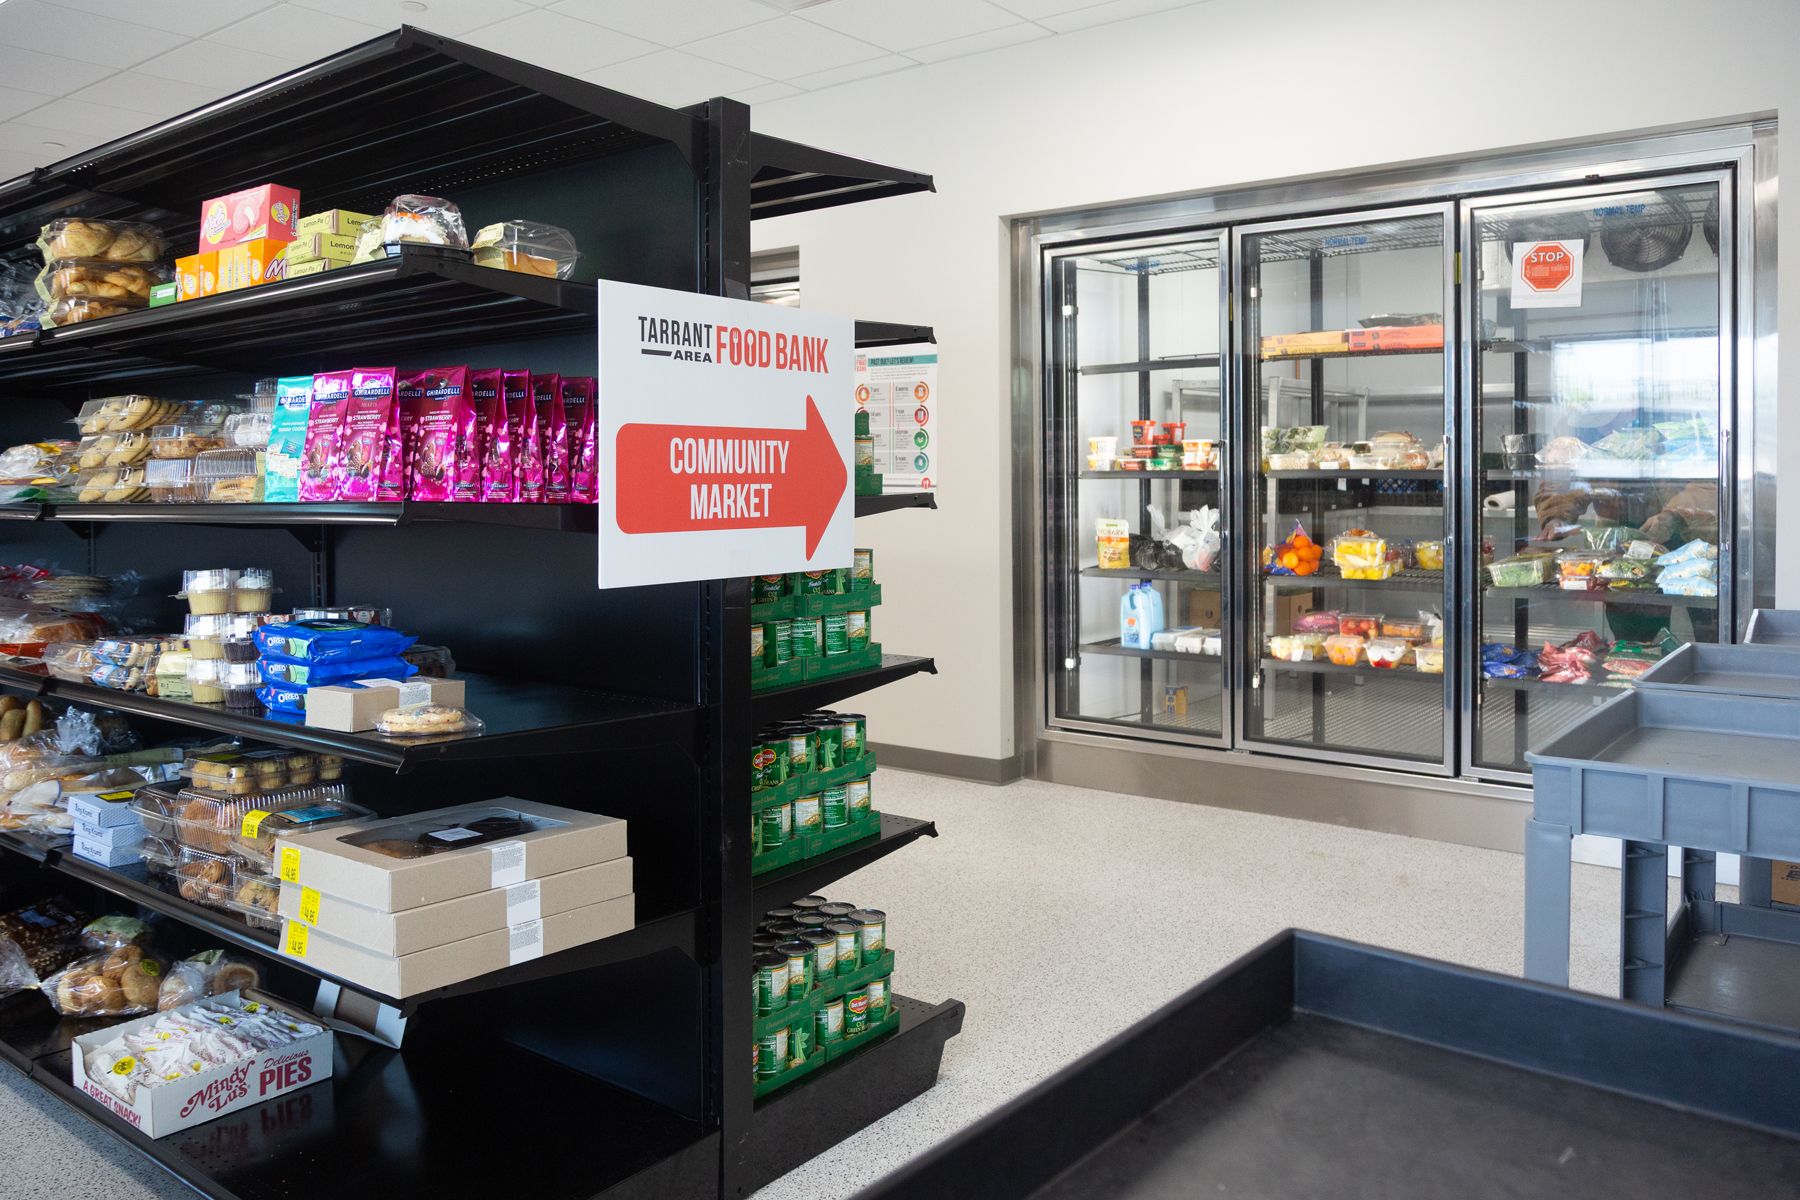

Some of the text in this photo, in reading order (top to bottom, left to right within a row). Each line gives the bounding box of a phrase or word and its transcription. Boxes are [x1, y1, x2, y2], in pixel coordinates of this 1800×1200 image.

[1593, 203, 1646, 217] NORMAL TEMP
[330, 240, 355, 250] Lemon
[1530, 251, 1565, 264] STOP
[638, 315, 713, 348] TARRANT
[673, 349, 713, 363] AREA
[716, 325, 829, 374] FOOD BANK
[427, 387, 460, 396] GHIRARDELLI
[314, 417, 339, 425] STRAWBERRY
[669, 437, 790, 475] COMMUNITY
[690, 483, 773, 520] MARKET
[267, 637, 286, 646] OREO
[268, 664, 287, 675] OREO
[278, 693, 300, 703] OREO
[263, 1049, 309, 1070] Delicious
[259, 1056, 312, 1097] PIES
[180, 1059, 256, 1119] Mindy
[83, 1080, 142, 1129] A GREAT SNACK!
